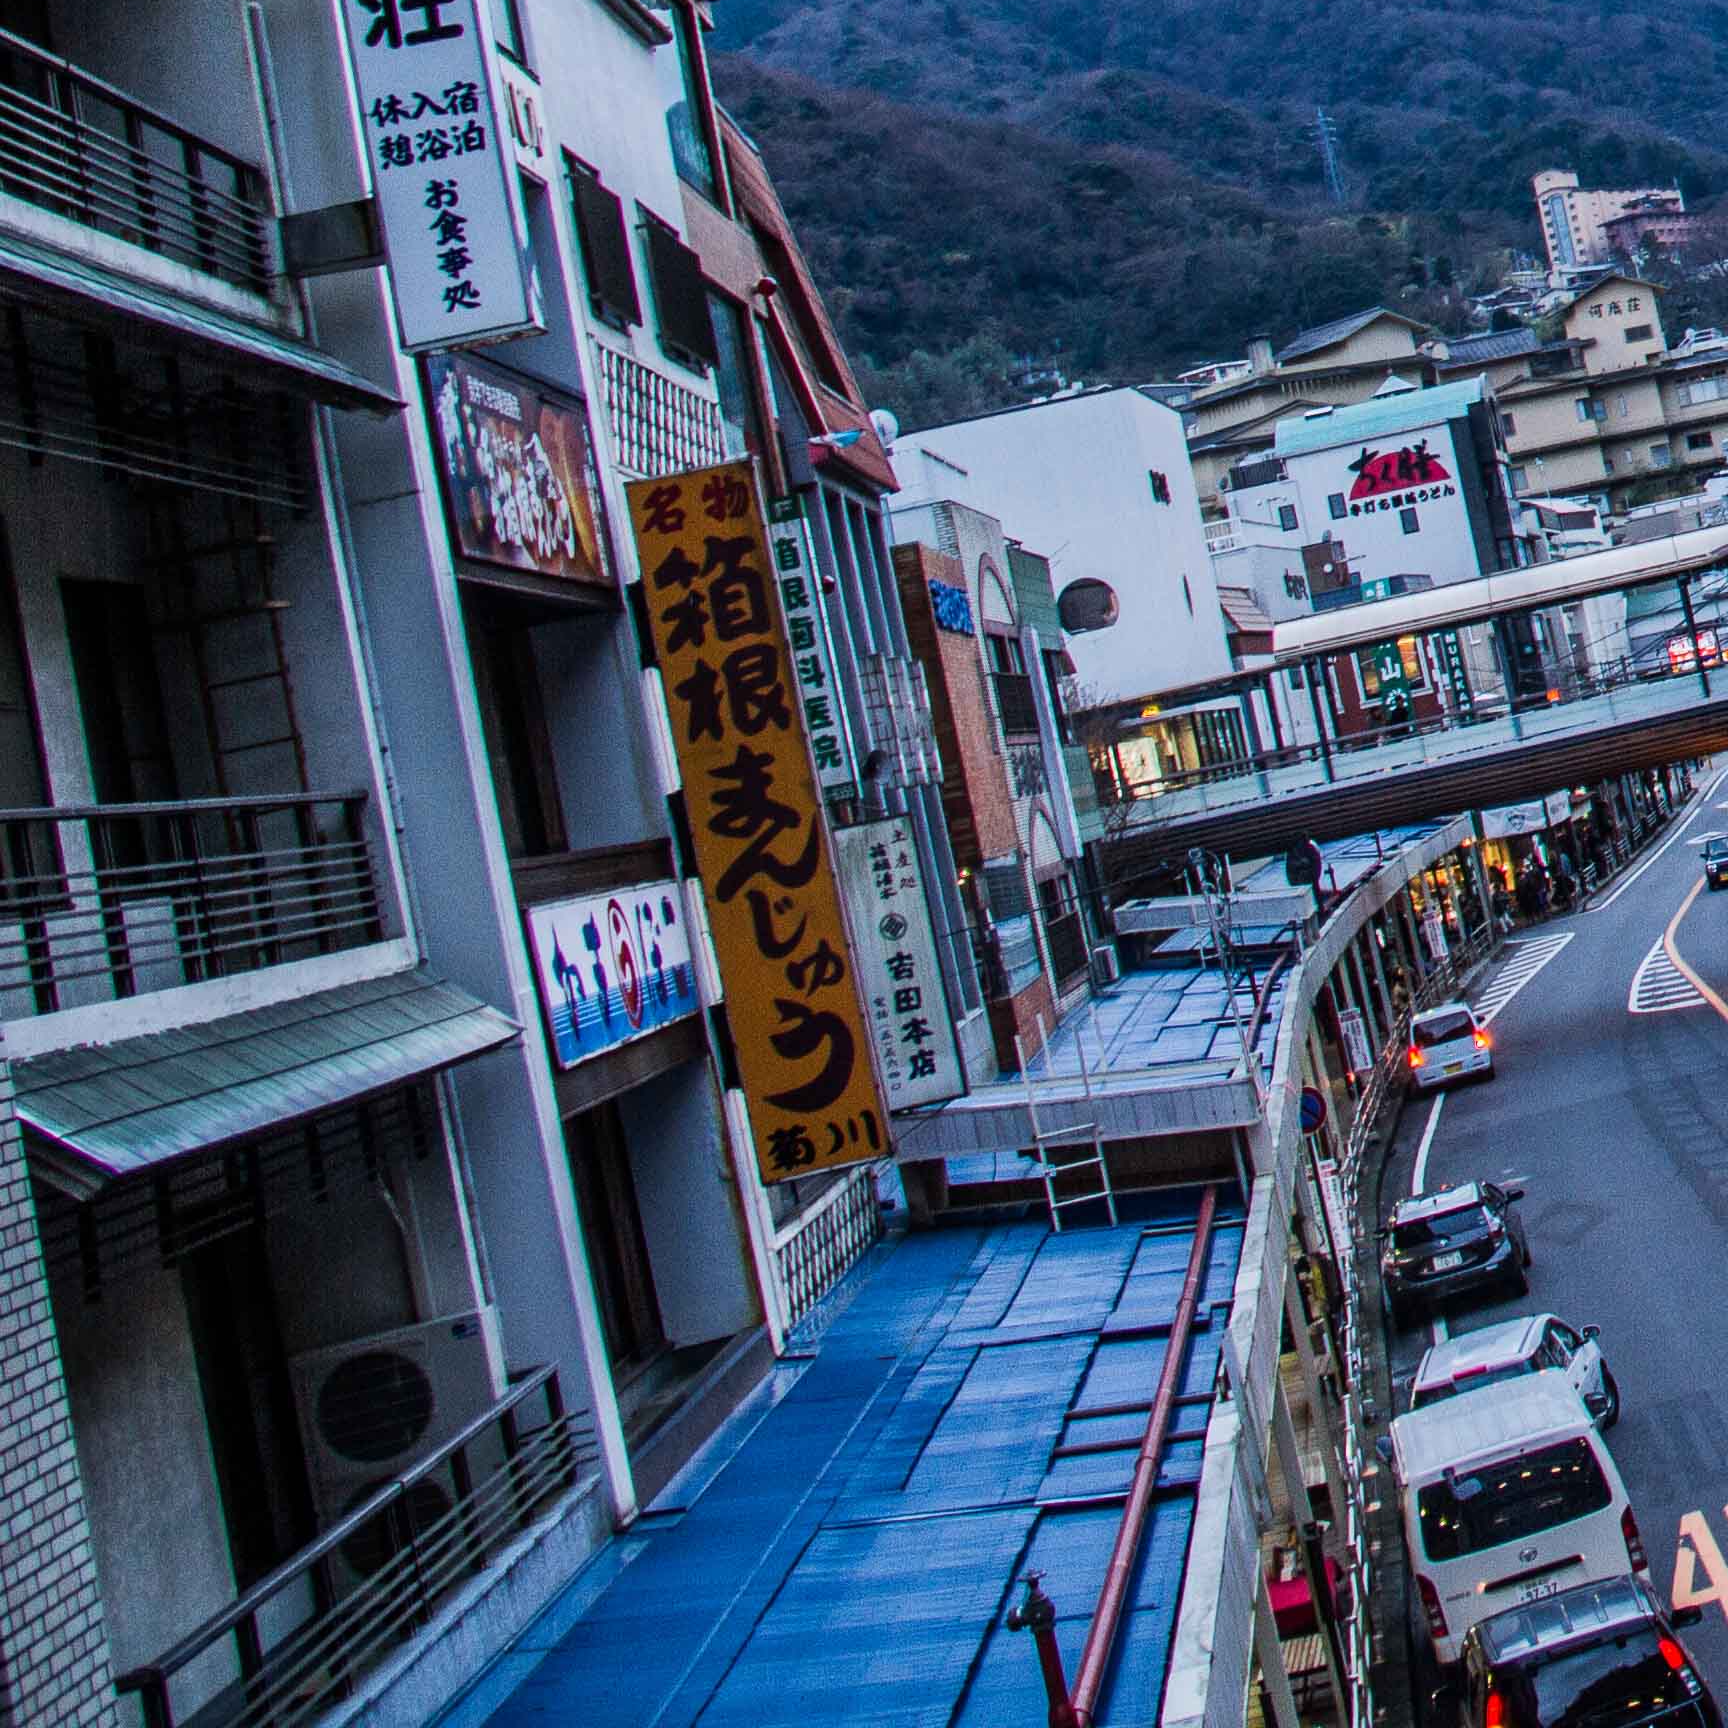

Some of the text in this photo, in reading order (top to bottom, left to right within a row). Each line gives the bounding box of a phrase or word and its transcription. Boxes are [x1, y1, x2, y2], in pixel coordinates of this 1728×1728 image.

[370, 93, 415, 170] 休憩
[409, 91, 454, 163] 入浴
[443, 80, 487, 156] 宿泊
[425, 179, 482, 313] お食事処
[641, 475, 750, 534] 名物
[653, 536, 855, 1113] 箱根まんじゅう
[886, 951, 937, 1082] 吉田本店
[767, 1109, 881, 1171] 菊川
